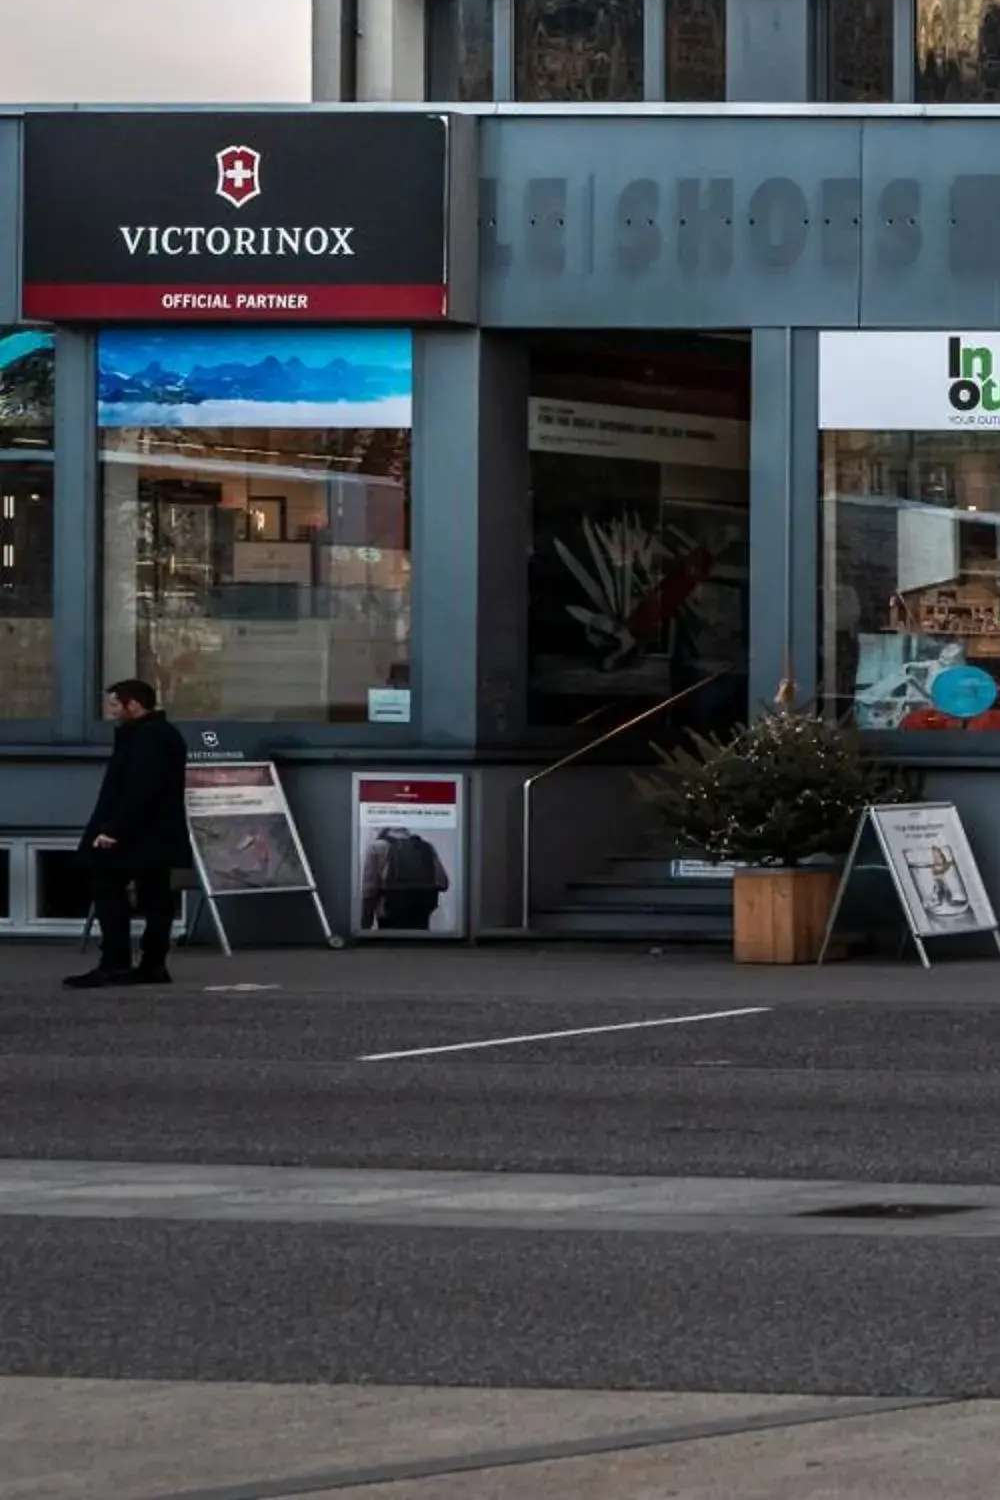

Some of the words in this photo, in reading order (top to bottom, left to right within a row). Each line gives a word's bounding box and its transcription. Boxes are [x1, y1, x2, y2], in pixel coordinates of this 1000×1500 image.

[118, 226, 356, 256] VICTORINOX
[161, 294, 231, 309] OFFICIAL
[236, 294, 308, 309] PARTNER
[948, 336, 992, 381] In
